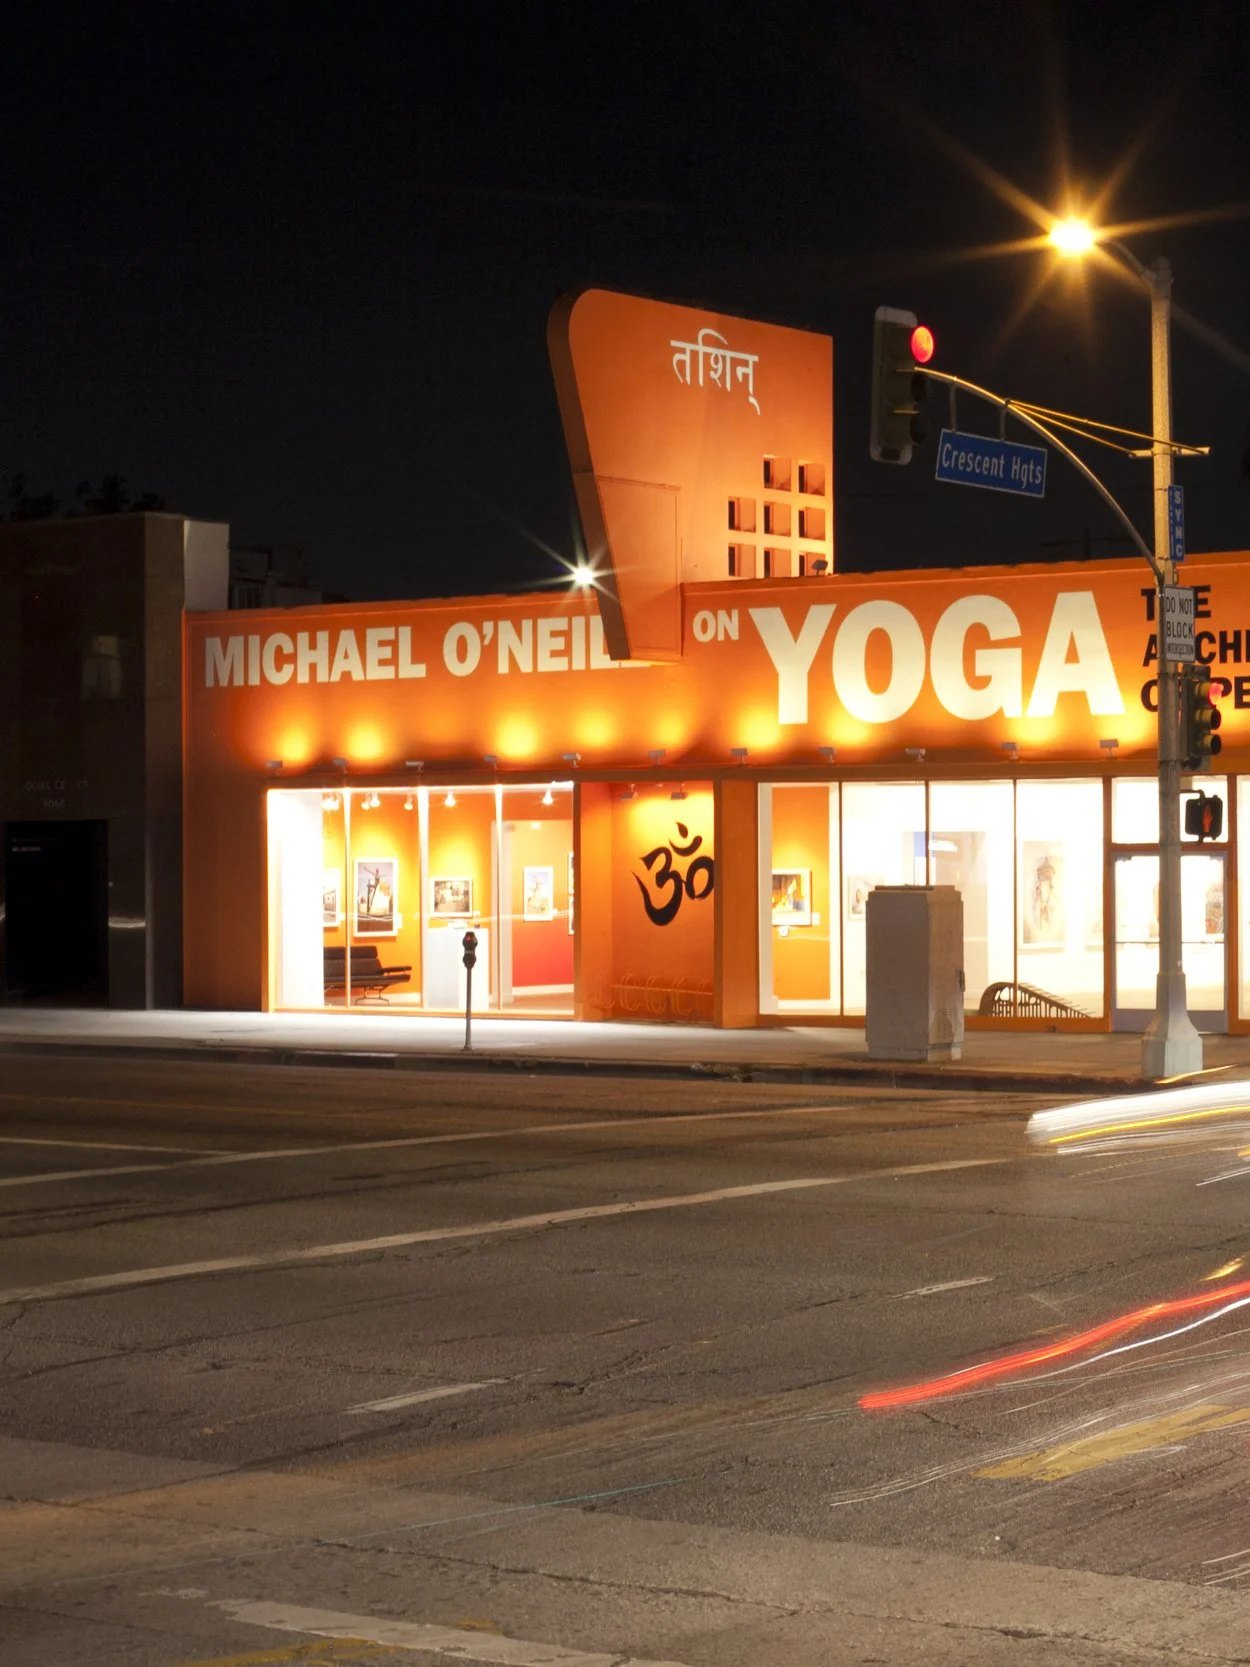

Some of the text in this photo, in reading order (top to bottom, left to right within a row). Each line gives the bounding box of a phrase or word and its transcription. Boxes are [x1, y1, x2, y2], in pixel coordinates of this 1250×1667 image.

[671, 328, 760, 415] तशिन्
[942, 443, 1042, 488] Crescent Hgts
[1141, 585, 1211, 621] TE
[1165, 597, 1193, 615] DO NOT
[205, 615, 652, 687] MICHAEL O'NEIL
[1166, 622, 1194, 640] BLOCK
[1167, 643, 1194, 656] INTERSECTION
[693, 591, 1126, 725] ON YOGA
